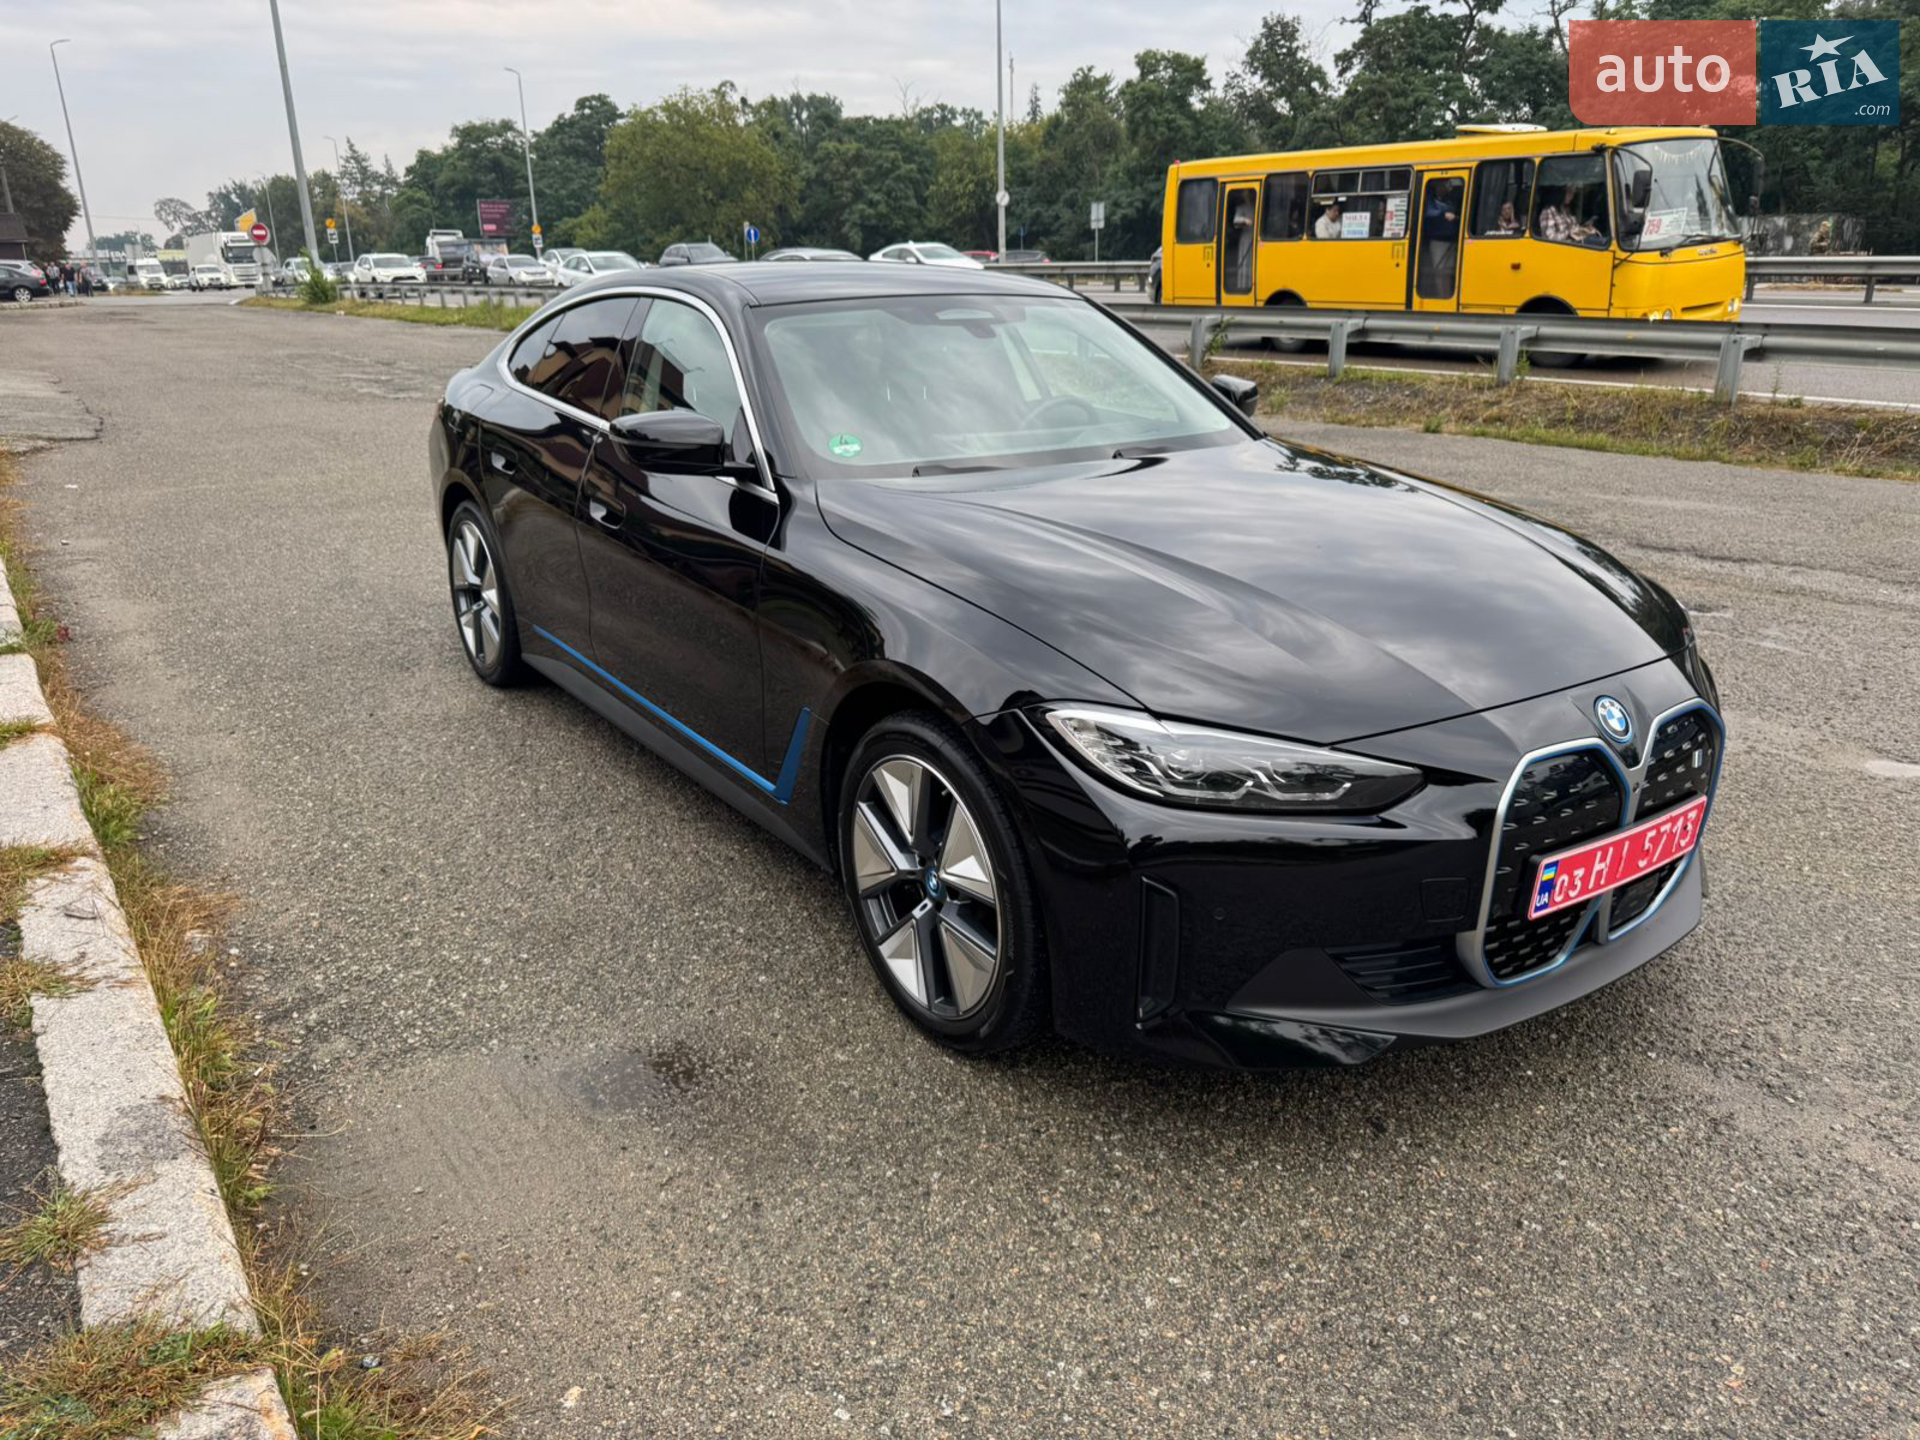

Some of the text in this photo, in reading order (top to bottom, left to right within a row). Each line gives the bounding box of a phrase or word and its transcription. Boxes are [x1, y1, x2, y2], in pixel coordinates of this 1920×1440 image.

[1554, 867, 1585, 902] 03
[1637, 809, 1699, 869] 5713
[1535, 892, 1549, 907] UA
